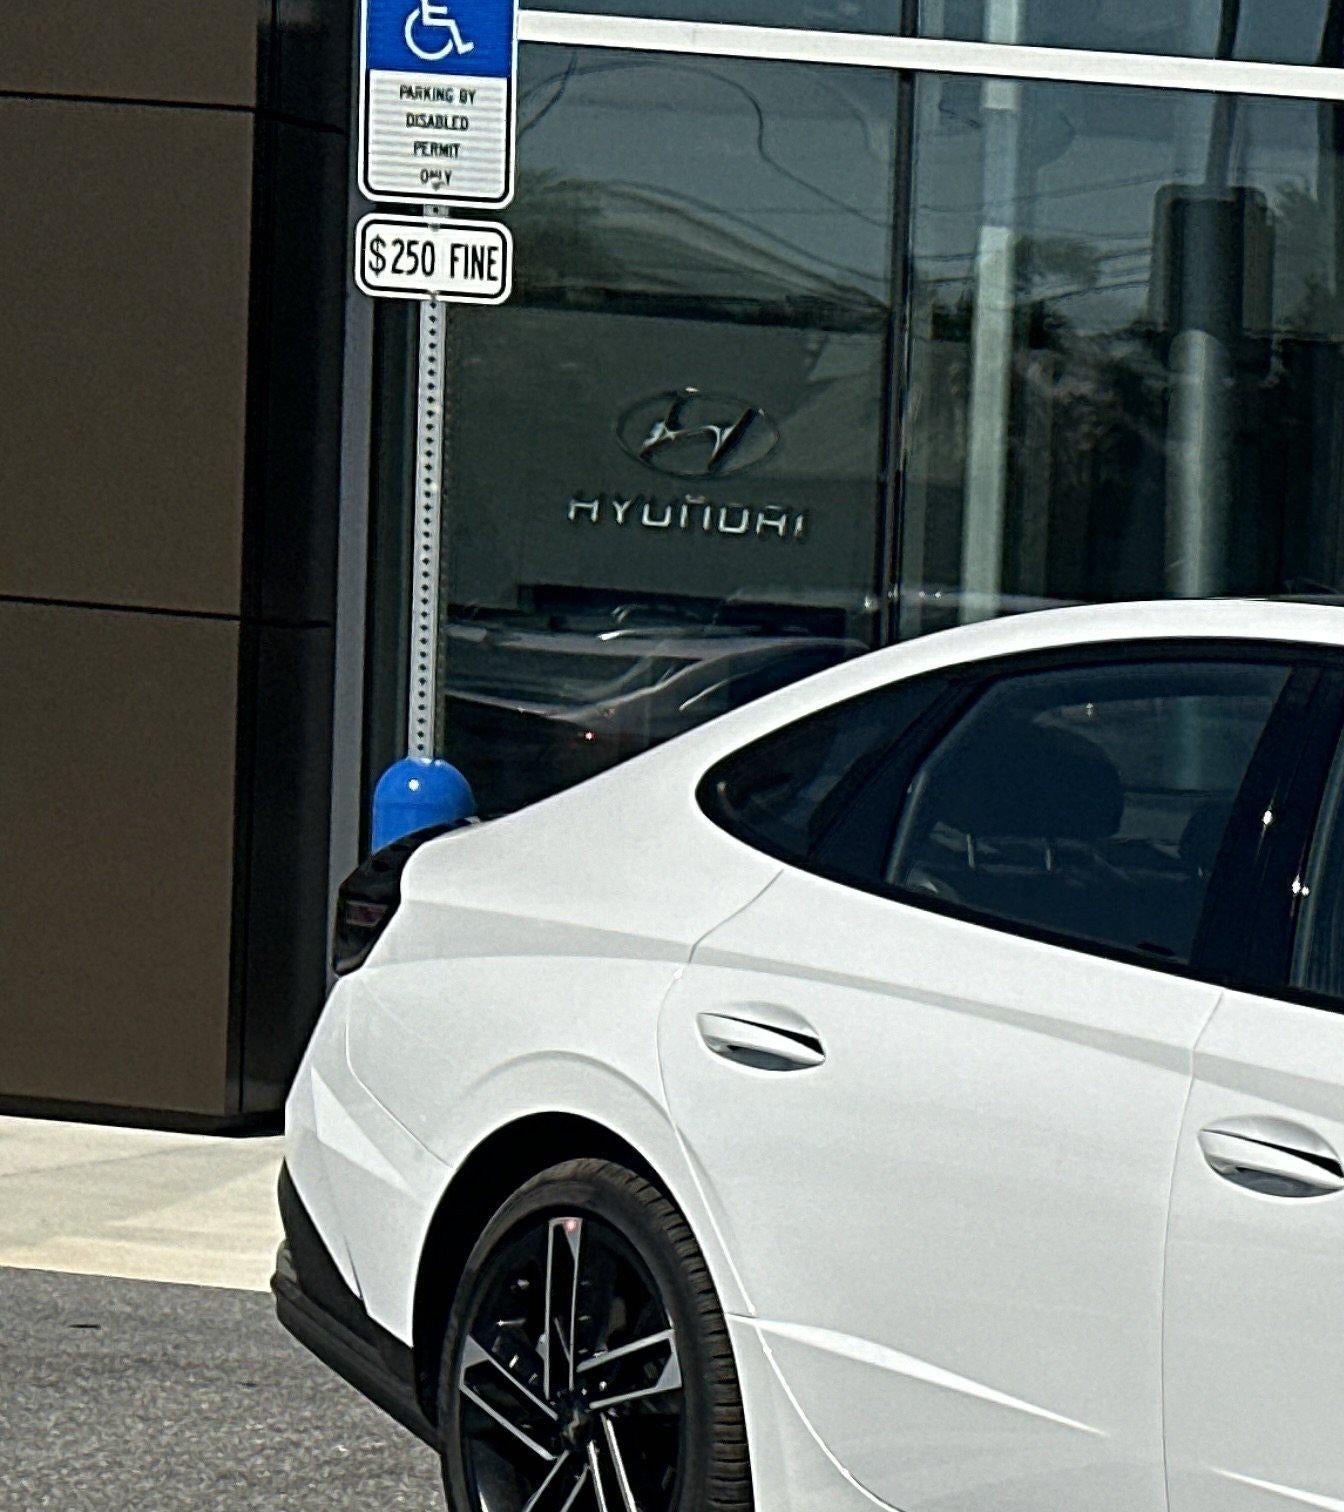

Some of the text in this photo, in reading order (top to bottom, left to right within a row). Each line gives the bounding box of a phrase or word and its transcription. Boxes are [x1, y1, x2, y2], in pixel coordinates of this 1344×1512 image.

[399, 84, 476, 105] PARKING BY
[406, 112, 469, 131] DISABLED
[413, 140, 460, 158] PERMIT
[368, 233, 499, 281] $250 FINE
[568, 495, 805, 537] HYUNDAI
